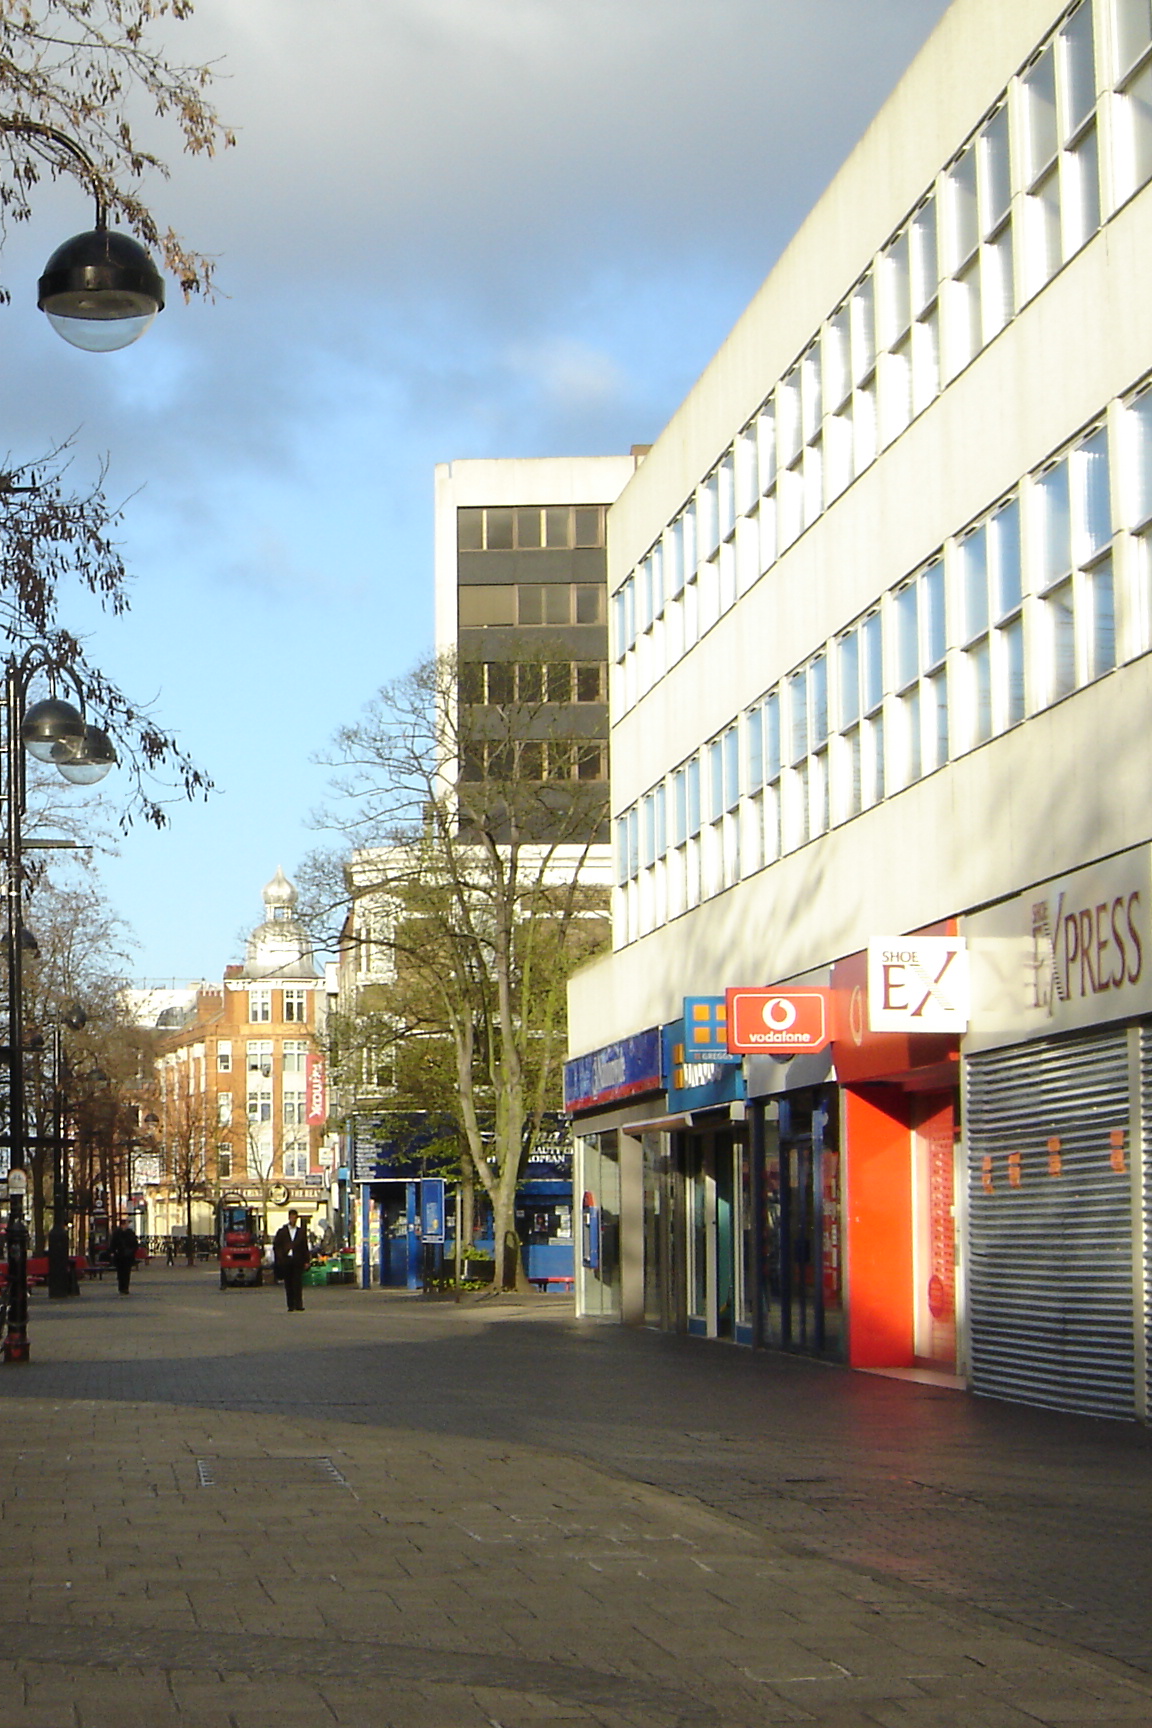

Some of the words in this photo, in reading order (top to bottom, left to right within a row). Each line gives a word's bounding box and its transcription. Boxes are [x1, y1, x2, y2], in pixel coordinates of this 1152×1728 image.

[882, 951, 919, 963] SHOE
[882, 951, 957, 1017] EX
[749, 1032, 811, 1043] vodafone
